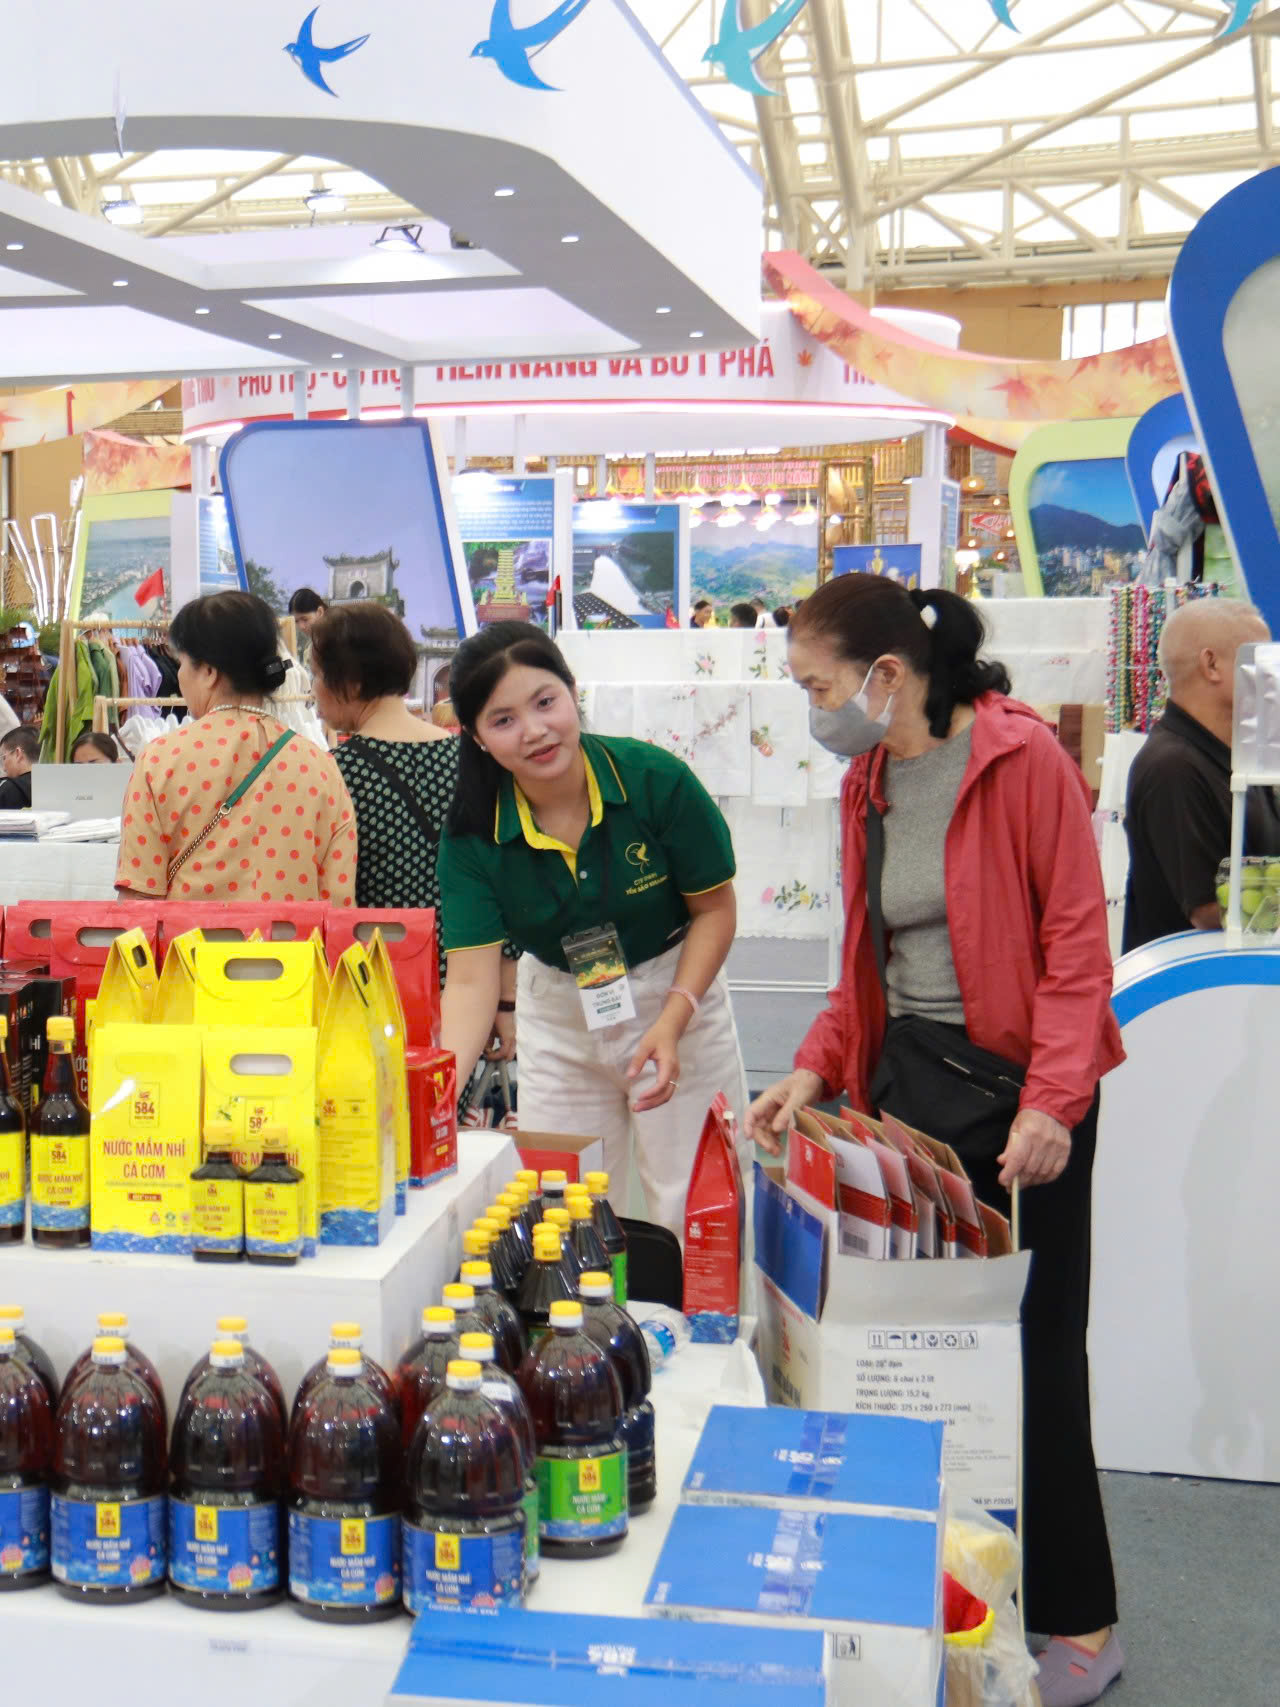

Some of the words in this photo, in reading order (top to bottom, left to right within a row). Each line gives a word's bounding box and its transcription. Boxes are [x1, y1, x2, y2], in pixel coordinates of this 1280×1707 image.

[720, 337, 775, 377] PHÁ
[134, 1101, 155, 1115] 584
[103, 1140, 132, 1156] NƯỚC
[135, 1136, 163, 1157] MẮM
[166, 1138, 186, 1158] NHỈ
[51, 1151, 67, 1161] 584
[123, 1161, 138, 1178] CÁ
[141, 1163, 166, 1179] CƠM
[856, 1388, 878, 1398] TRỌNG
[855, 1400, 872, 1410] KÍCH
